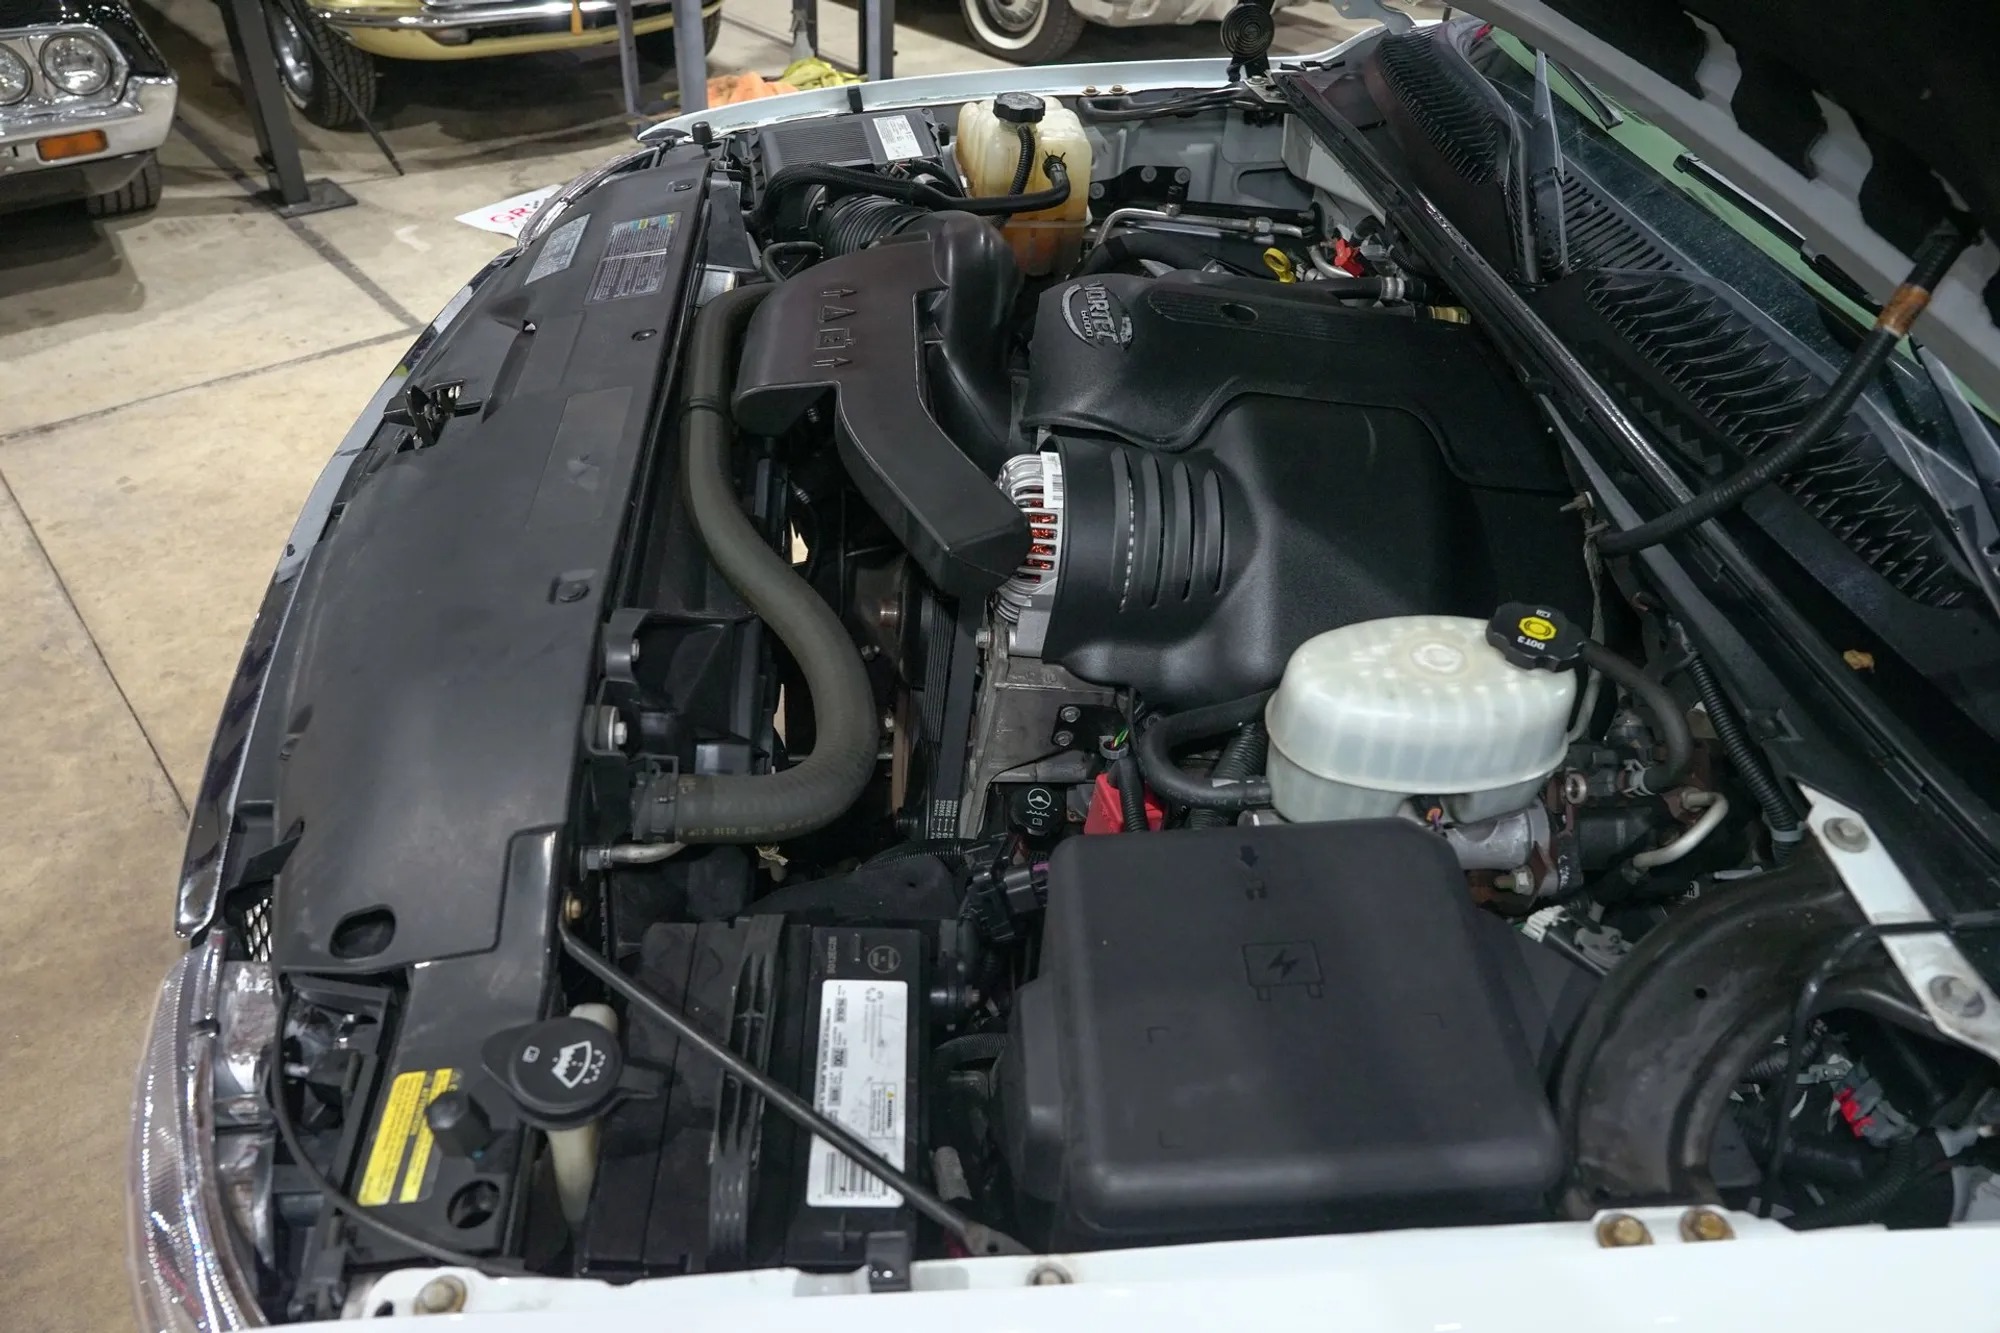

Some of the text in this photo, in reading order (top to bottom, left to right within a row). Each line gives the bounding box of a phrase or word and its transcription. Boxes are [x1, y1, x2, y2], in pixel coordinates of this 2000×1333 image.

[1081, 310, 1093, 337] 6000
[1084, 282, 1119, 345] VORTEC
[1517, 635, 1546, 650] DOT 3
